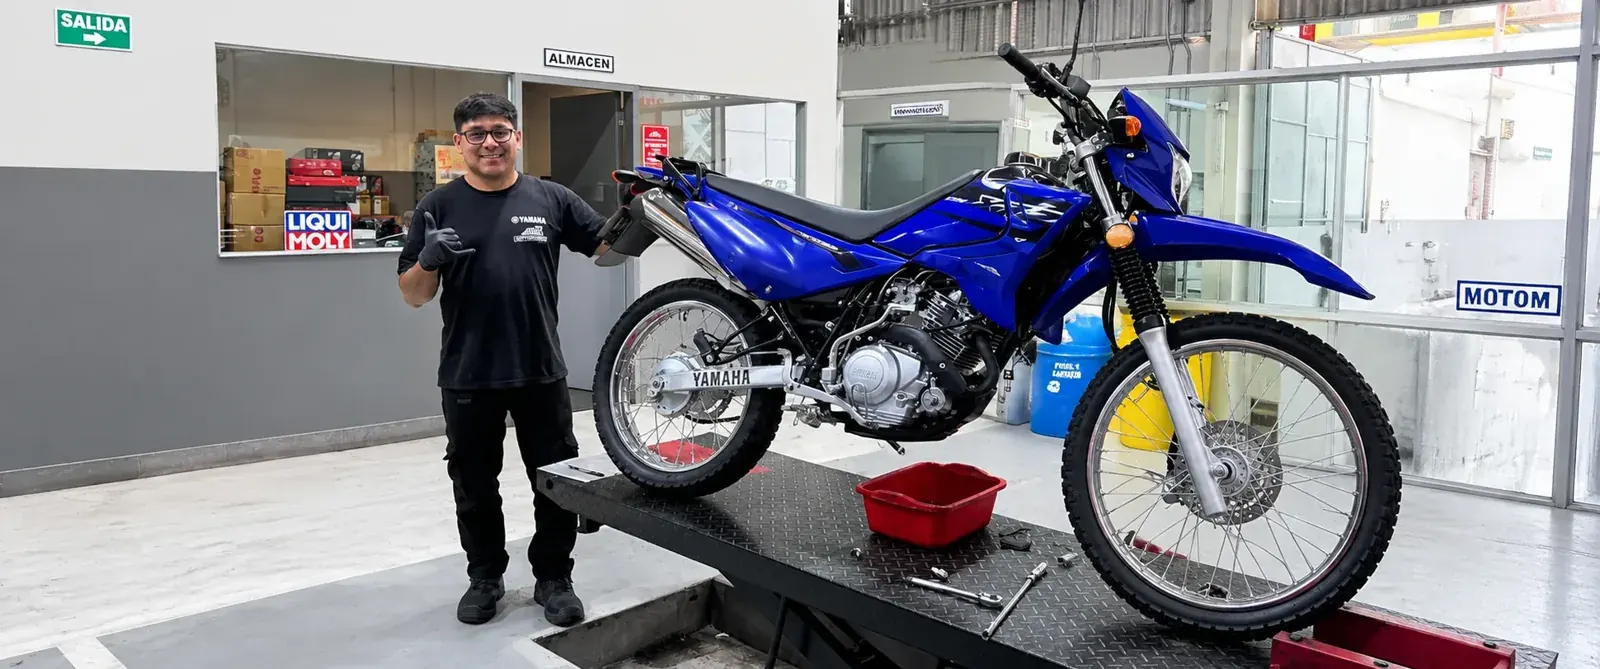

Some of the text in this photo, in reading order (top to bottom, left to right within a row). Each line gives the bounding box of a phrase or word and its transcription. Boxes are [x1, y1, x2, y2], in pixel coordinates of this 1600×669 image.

[61, 13, 127, 33] SALIDA
[549, 53, 610, 69] ALMACEN
[288, 213, 348, 231] LIQUI
[288, 232, 349, 250] MOLY
[1465, 287, 1550, 309] MOTOM
[693, 369, 751, 387] YAMAHA
